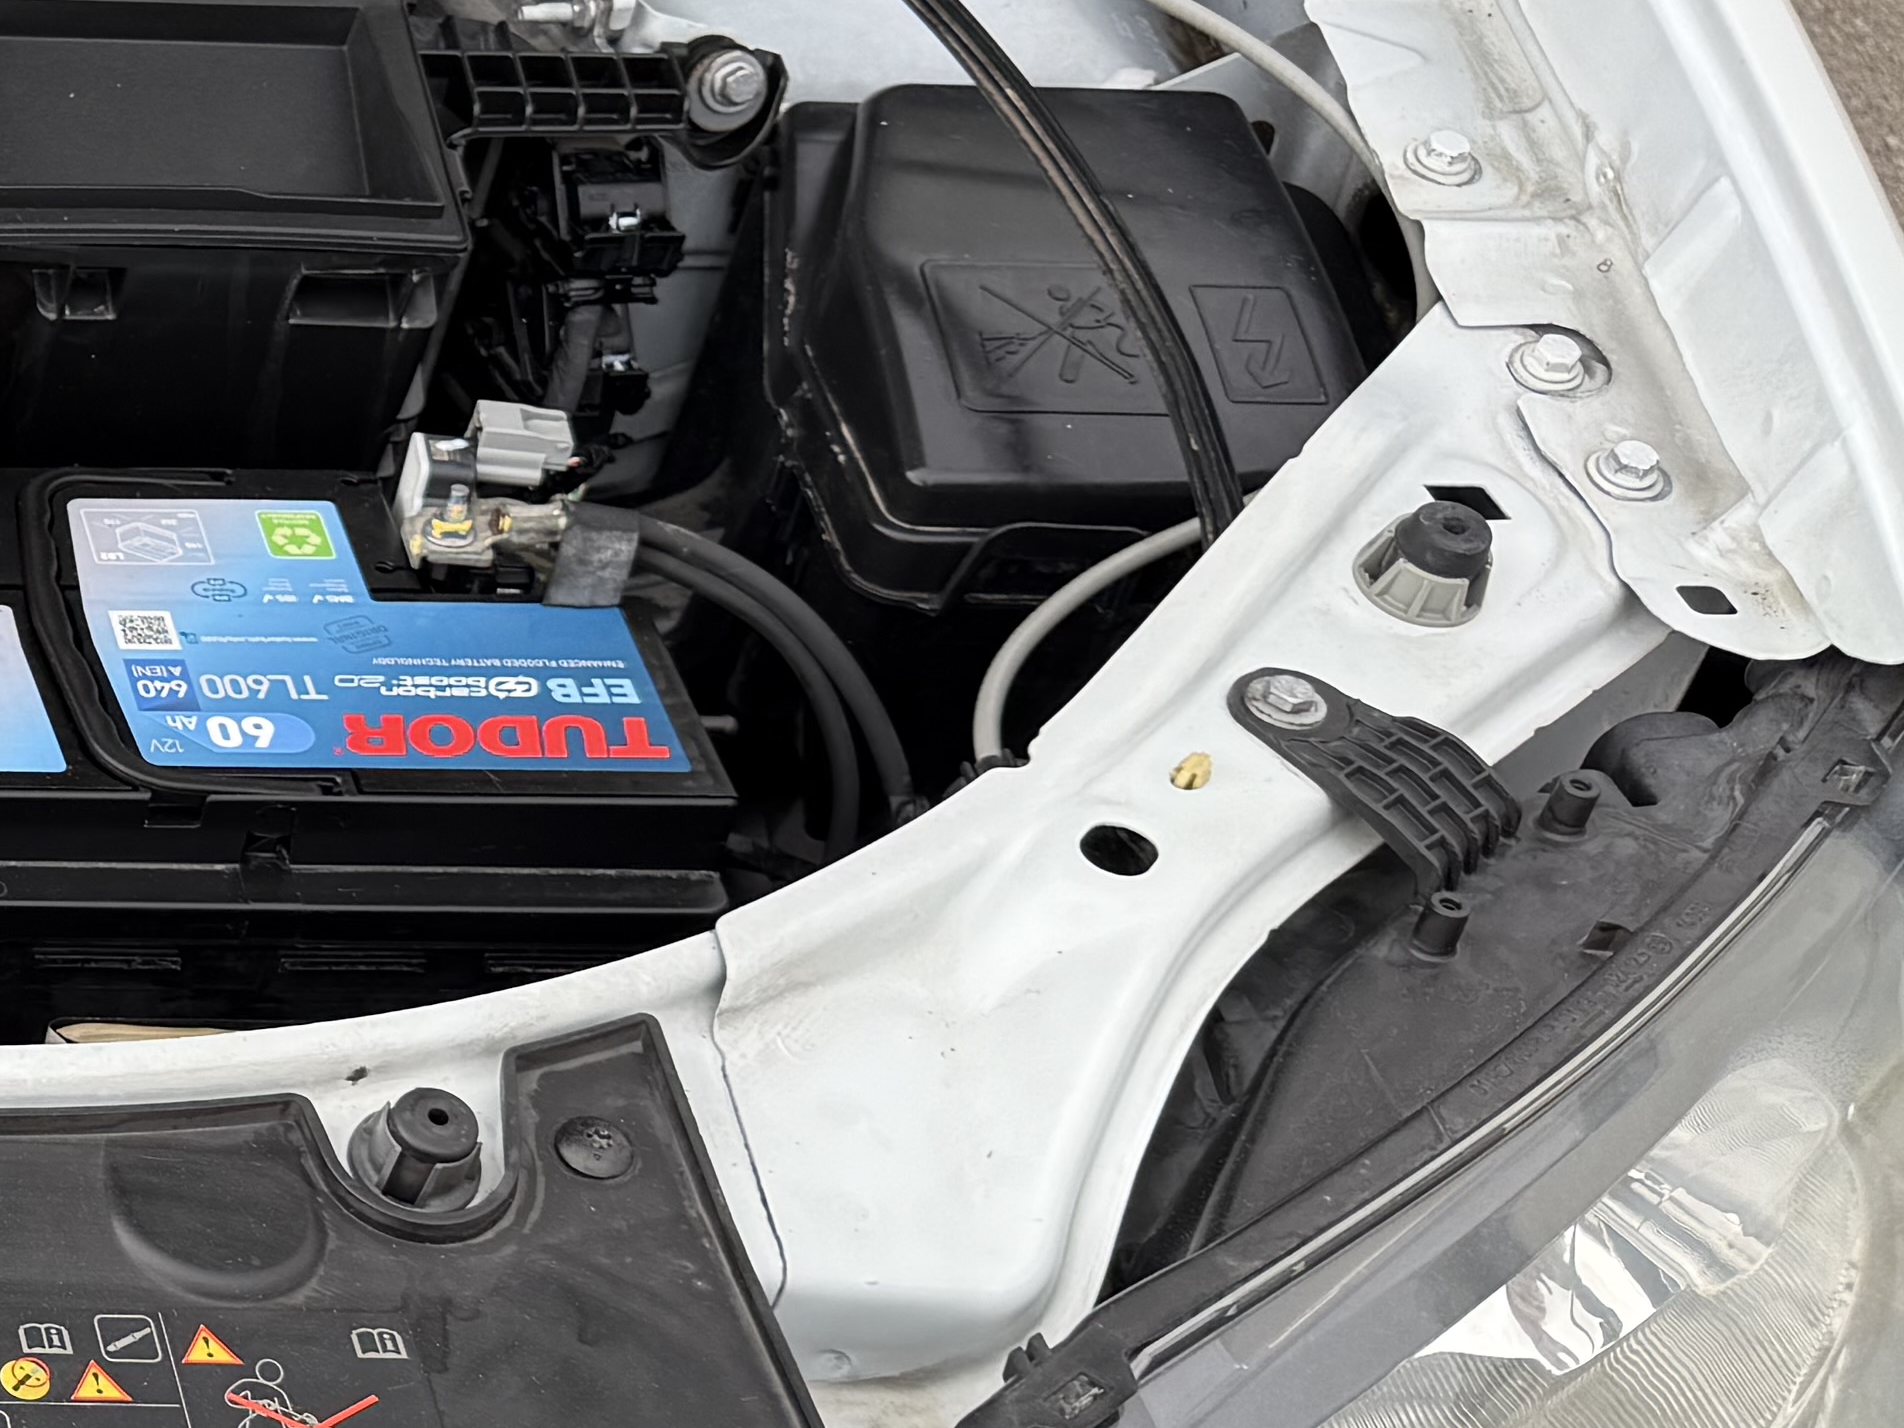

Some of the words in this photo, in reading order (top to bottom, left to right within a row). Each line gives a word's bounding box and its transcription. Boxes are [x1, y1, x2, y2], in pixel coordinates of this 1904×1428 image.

[372, 657, 449, 666] TECHNOLOGY
[450, 658, 502, 667] BATTERY
[502, 658, 557, 668] FLOODED
[558, 659, 626, 669] ENHANCED
[131, 664, 166, 678] (EN)
[167, 665, 182, 677] A
[198, 673, 329, 700] TL600
[399, 675, 489, 687] boost
[136, 679, 188, 699] 640
[379, 685, 489, 699] carbon
[548, 677, 641, 704] EFB
[166, 715, 198, 732] Ah
[205, 715, 275, 749] 60
[342, 714, 670, 758] TUDOR
[150, 738, 184, 753] 12V
